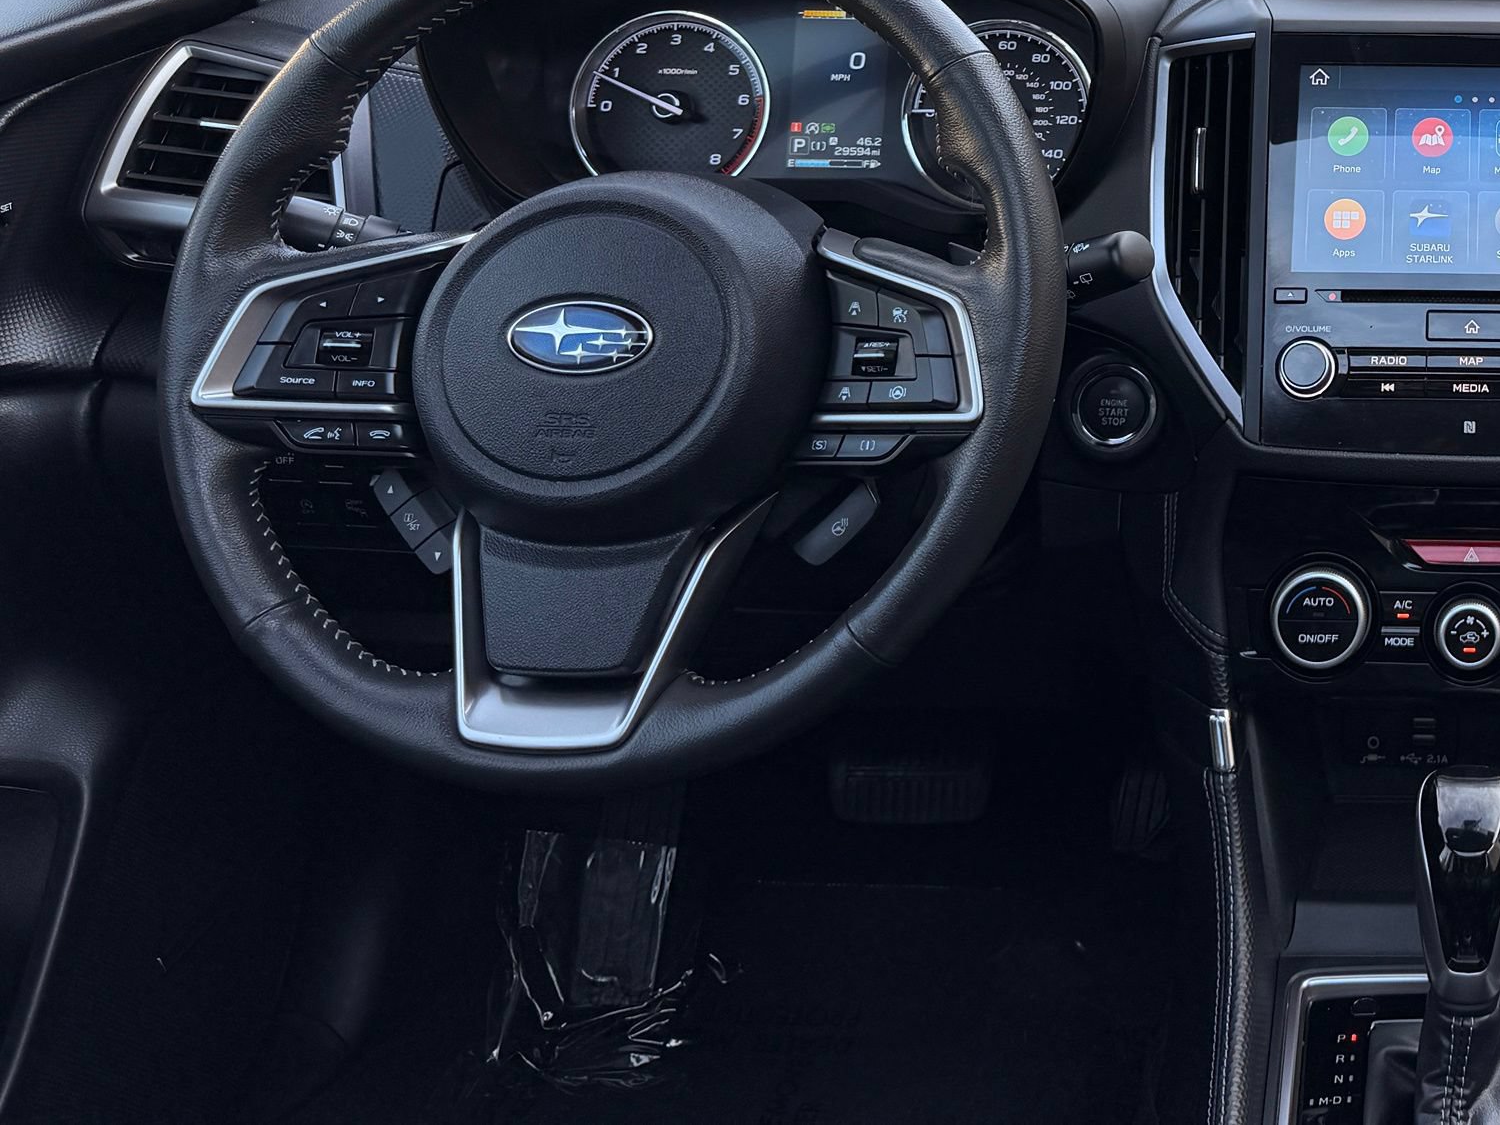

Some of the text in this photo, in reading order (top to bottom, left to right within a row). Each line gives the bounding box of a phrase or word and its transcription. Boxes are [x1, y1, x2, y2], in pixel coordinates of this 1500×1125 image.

[670, 34, 682, 46] 3
[635, 43, 648, 54] 2
[703, 42, 715, 53] 4
[998, 40, 1017, 51] 60
[848, 52, 866, 72] 0
[1031, 53, 1050, 64] 80
[613, 67, 620, 77] 1
[728, 64, 740, 75] 5
[830, 73, 852, 83] MPH
[1049, 81, 1072, 91] 100
[737, 95, 750, 106] 6
[600, 101, 613, 112] 0
[1056, 115, 1078, 125] 120
[732, 128, 744, 139] 7
[793, 139, 806, 153] P
[856, 137, 883, 146] 46.2
[834, 147, 871, 156] 29594
[709, 154, 722, 166] 8
[1333, 164, 1361, 174] Phone
[1422, 165, 1441, 175] Map
[0, 201, 13, 213] SET
[1409, 243, 1451, 253] SUBARU
[1332, 248, 1356, 259] Apps
[1406, 254, 1454, 264] STARLINK
[1370, 355, 1407, 366] RADIO
[1459, 356, 1484, 366] MAP
[279, 376, 315, 385] Source
[352, 379, 375, 387] INFO
[1452, 383, 1489, 394] MEDIA
[1101, 399, 1128, 407] ENGINE
[1098, 408, 1128, 416] START
[544, 412, 591, 426] SRS
[1102, 417, 1126, 426] STOP
[275, 456, 295, 464] OFF
[1303, 597, 1334, 608] AUTO
[1393, 600, 1412, 610] A/C
[1298, 634, 1339, 644] ON/OFF
[1384, 637, 1415, 647] MODE
[1426, 754, 1448, 764] 2.1A
[1337, 1034, 1346, 1043] P
[1335, 1054, 1345, 1063] R
[1334, 1075, 1343, 1084] N
